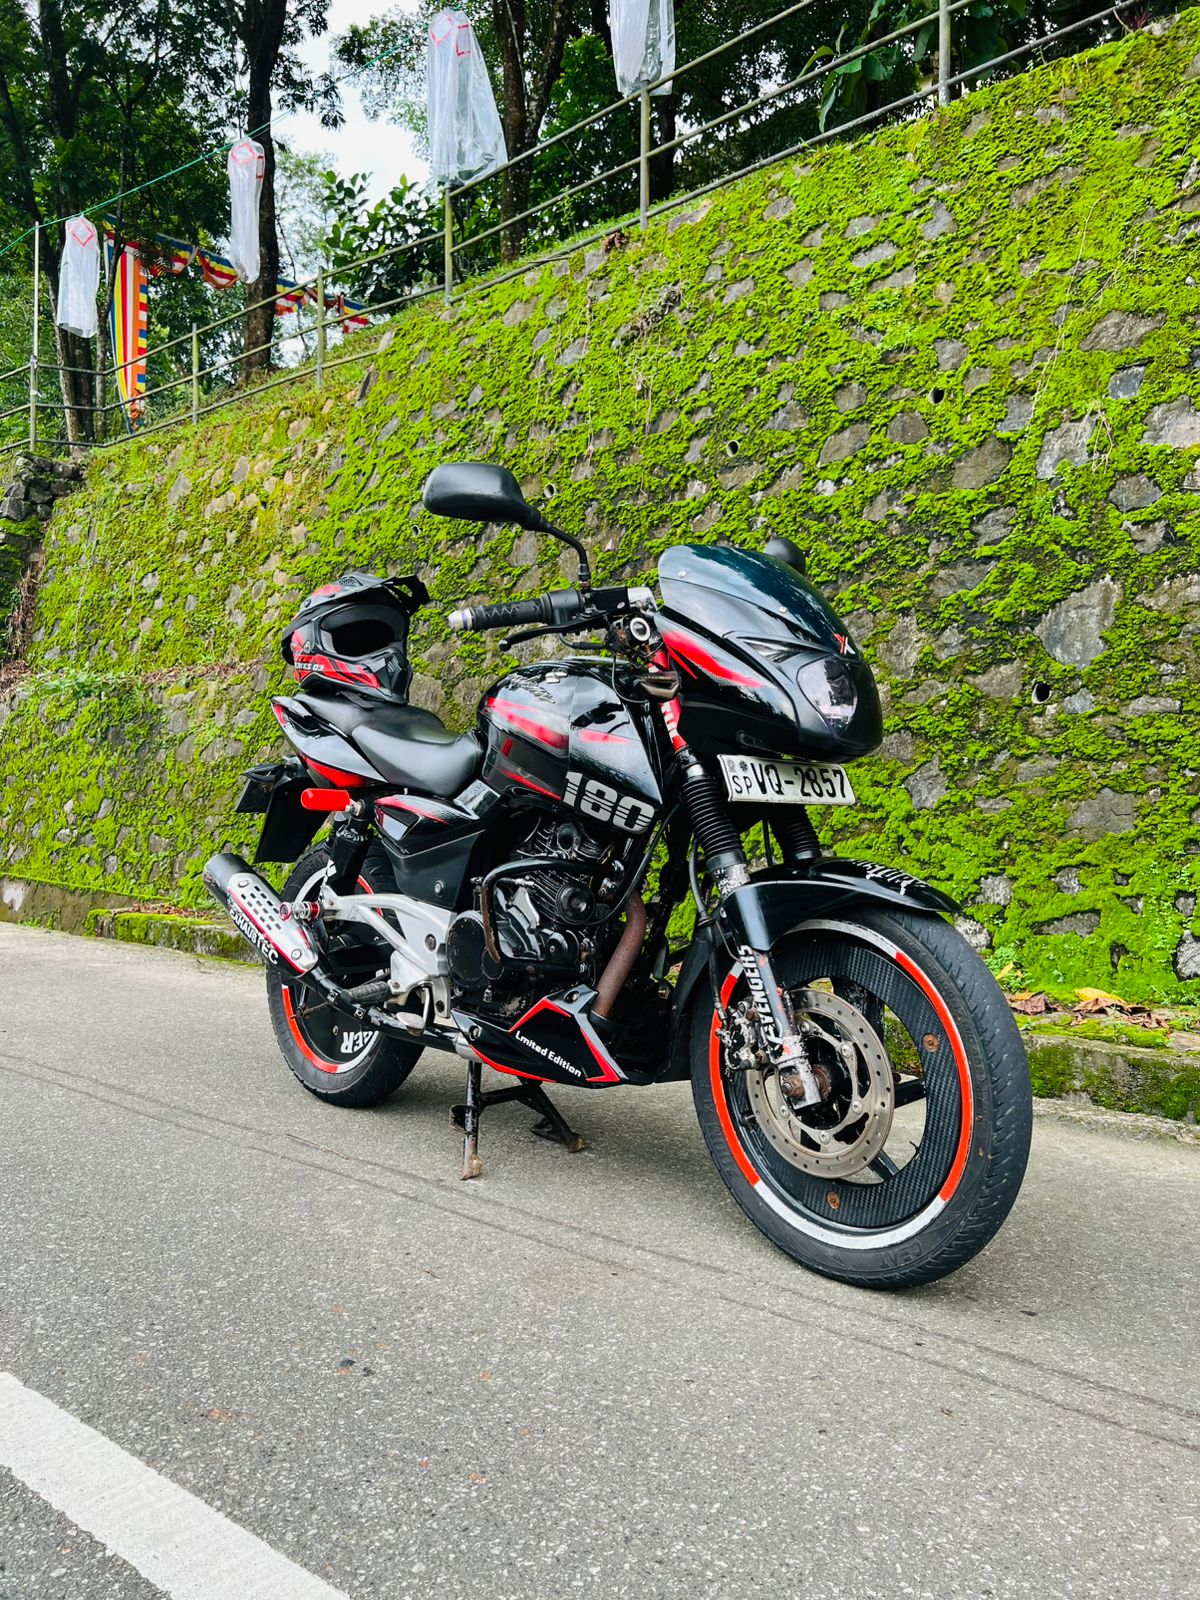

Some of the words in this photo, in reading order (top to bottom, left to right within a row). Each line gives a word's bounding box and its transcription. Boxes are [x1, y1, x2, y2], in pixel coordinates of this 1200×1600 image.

[731, 775, 752, 795] SP
[750, 763, 846, 798] VQ-2857
[563, 771, 655, 835] 180
[547, 1050, 582, 1078] Edition
